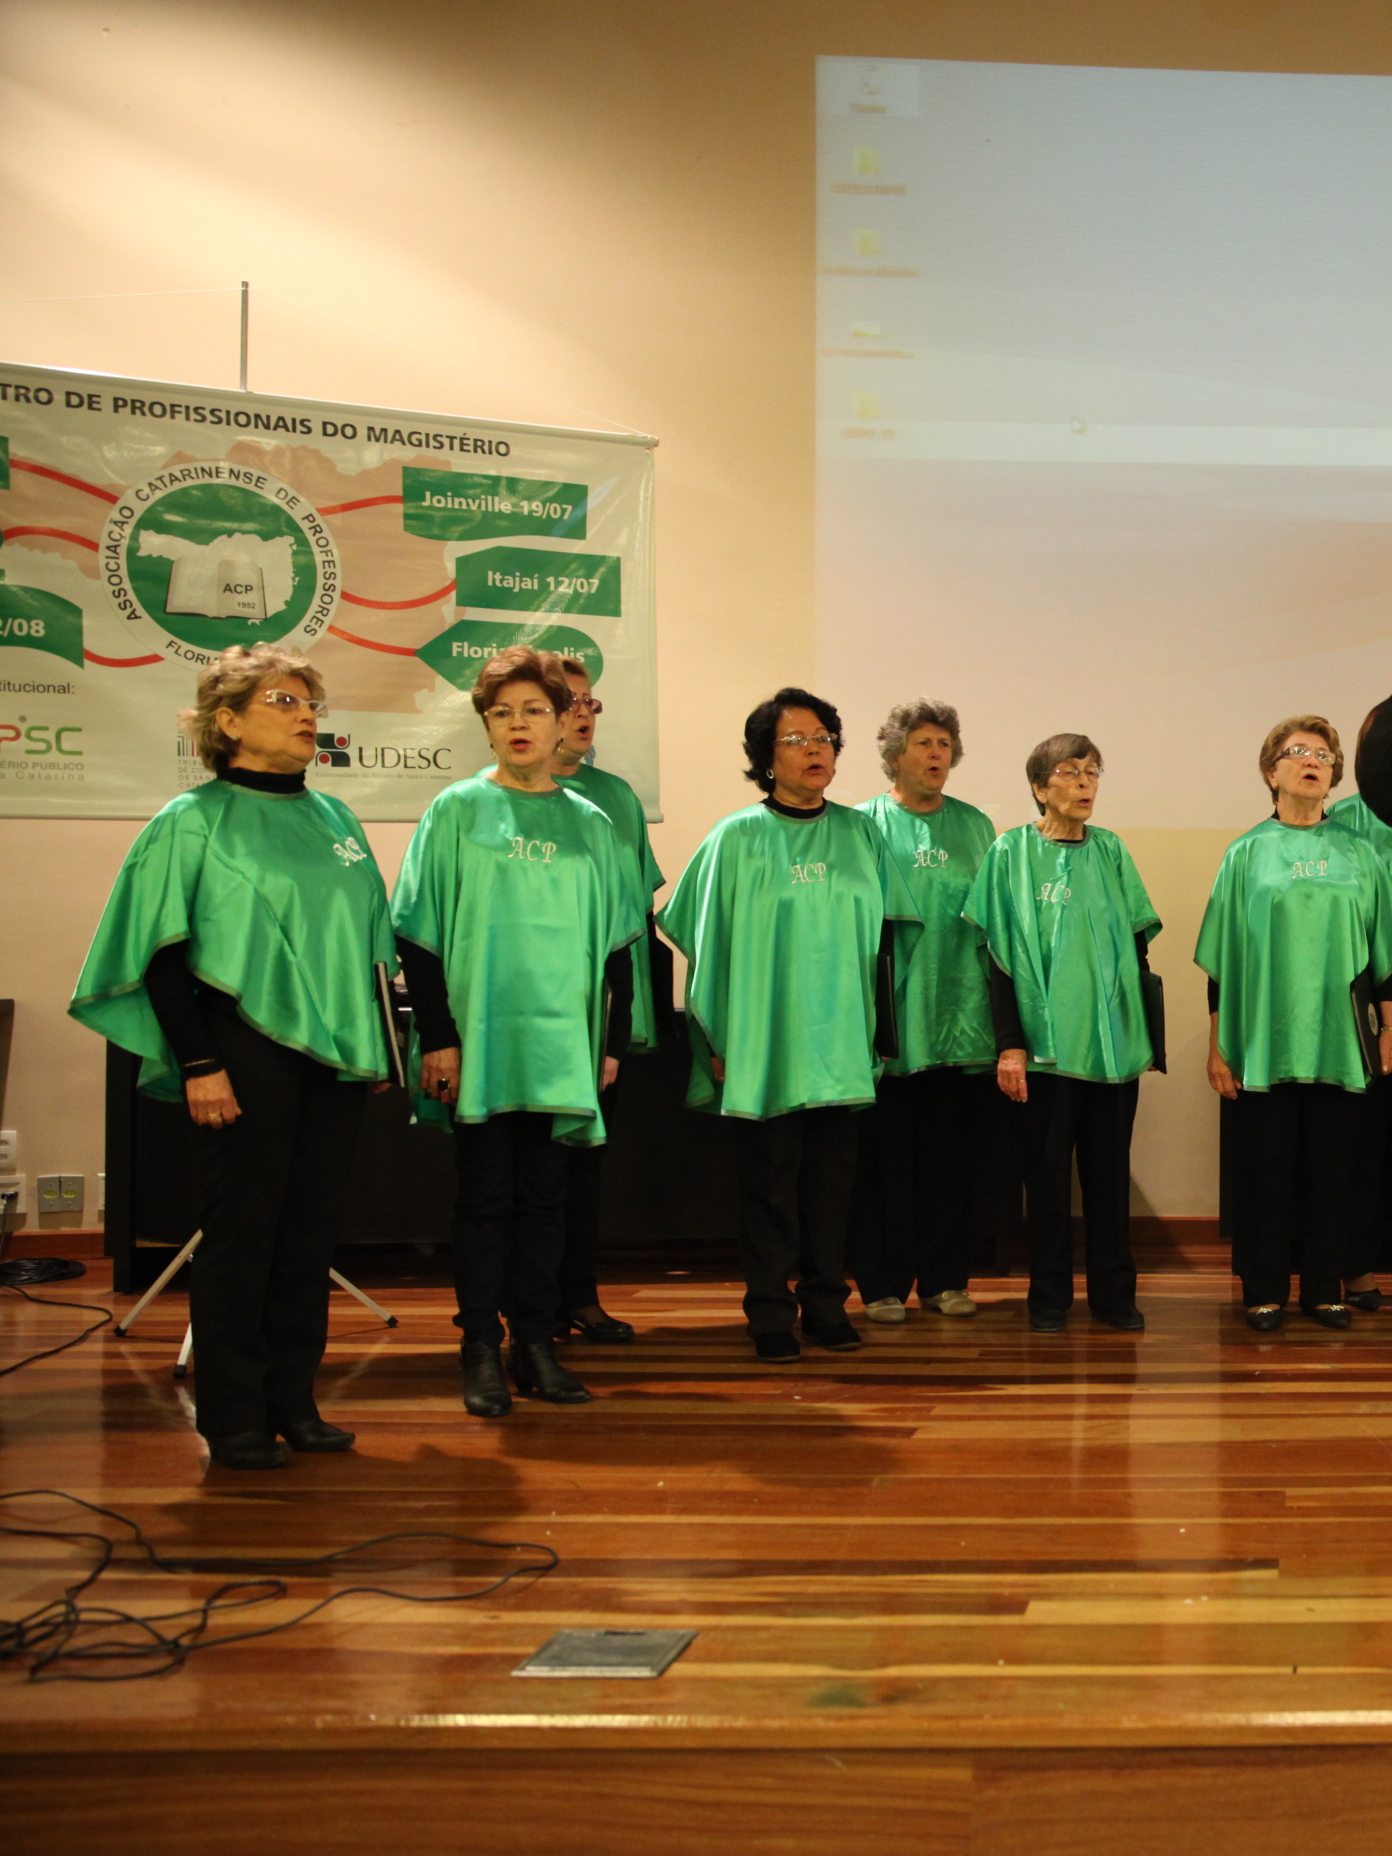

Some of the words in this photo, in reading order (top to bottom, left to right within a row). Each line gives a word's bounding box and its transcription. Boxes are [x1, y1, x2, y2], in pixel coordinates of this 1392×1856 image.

[65, 391, 103, 412] DE
[112, 396, 313, 435] PROFISSIONAIS
[321, 421, 358, 440] DO
[366, 425, 511, 457] MAGISTÉRIO
[421, 491, 513, 514] Joinville
[519, 500, 573, 520] 19/07
[105, 505, 143, 622] ASSOCIAÇÃO
[135, 466, 268, 502] CATARINENSE
[274, 487, 302, 510] DE
[301, 513, 337, 637] PROFESSORES
[222, 583, 254, 595] ACP
[487, 570, 539, 593] Itajaí
[546, 576, 600, 594] 12/07
[32, 759, 84, 771] PÚBLICO
[358, 746, 452, 770] UDESC
[16, 770, 84, 781] Catarina
[508, 836, 557, 864] ACP
[913, 849, 949, 869] ACP
[791, 862, 826, 885] ACP
[1291, 860, 1329, 879] ACP
[1036, 883, 1072, 905] ACP
